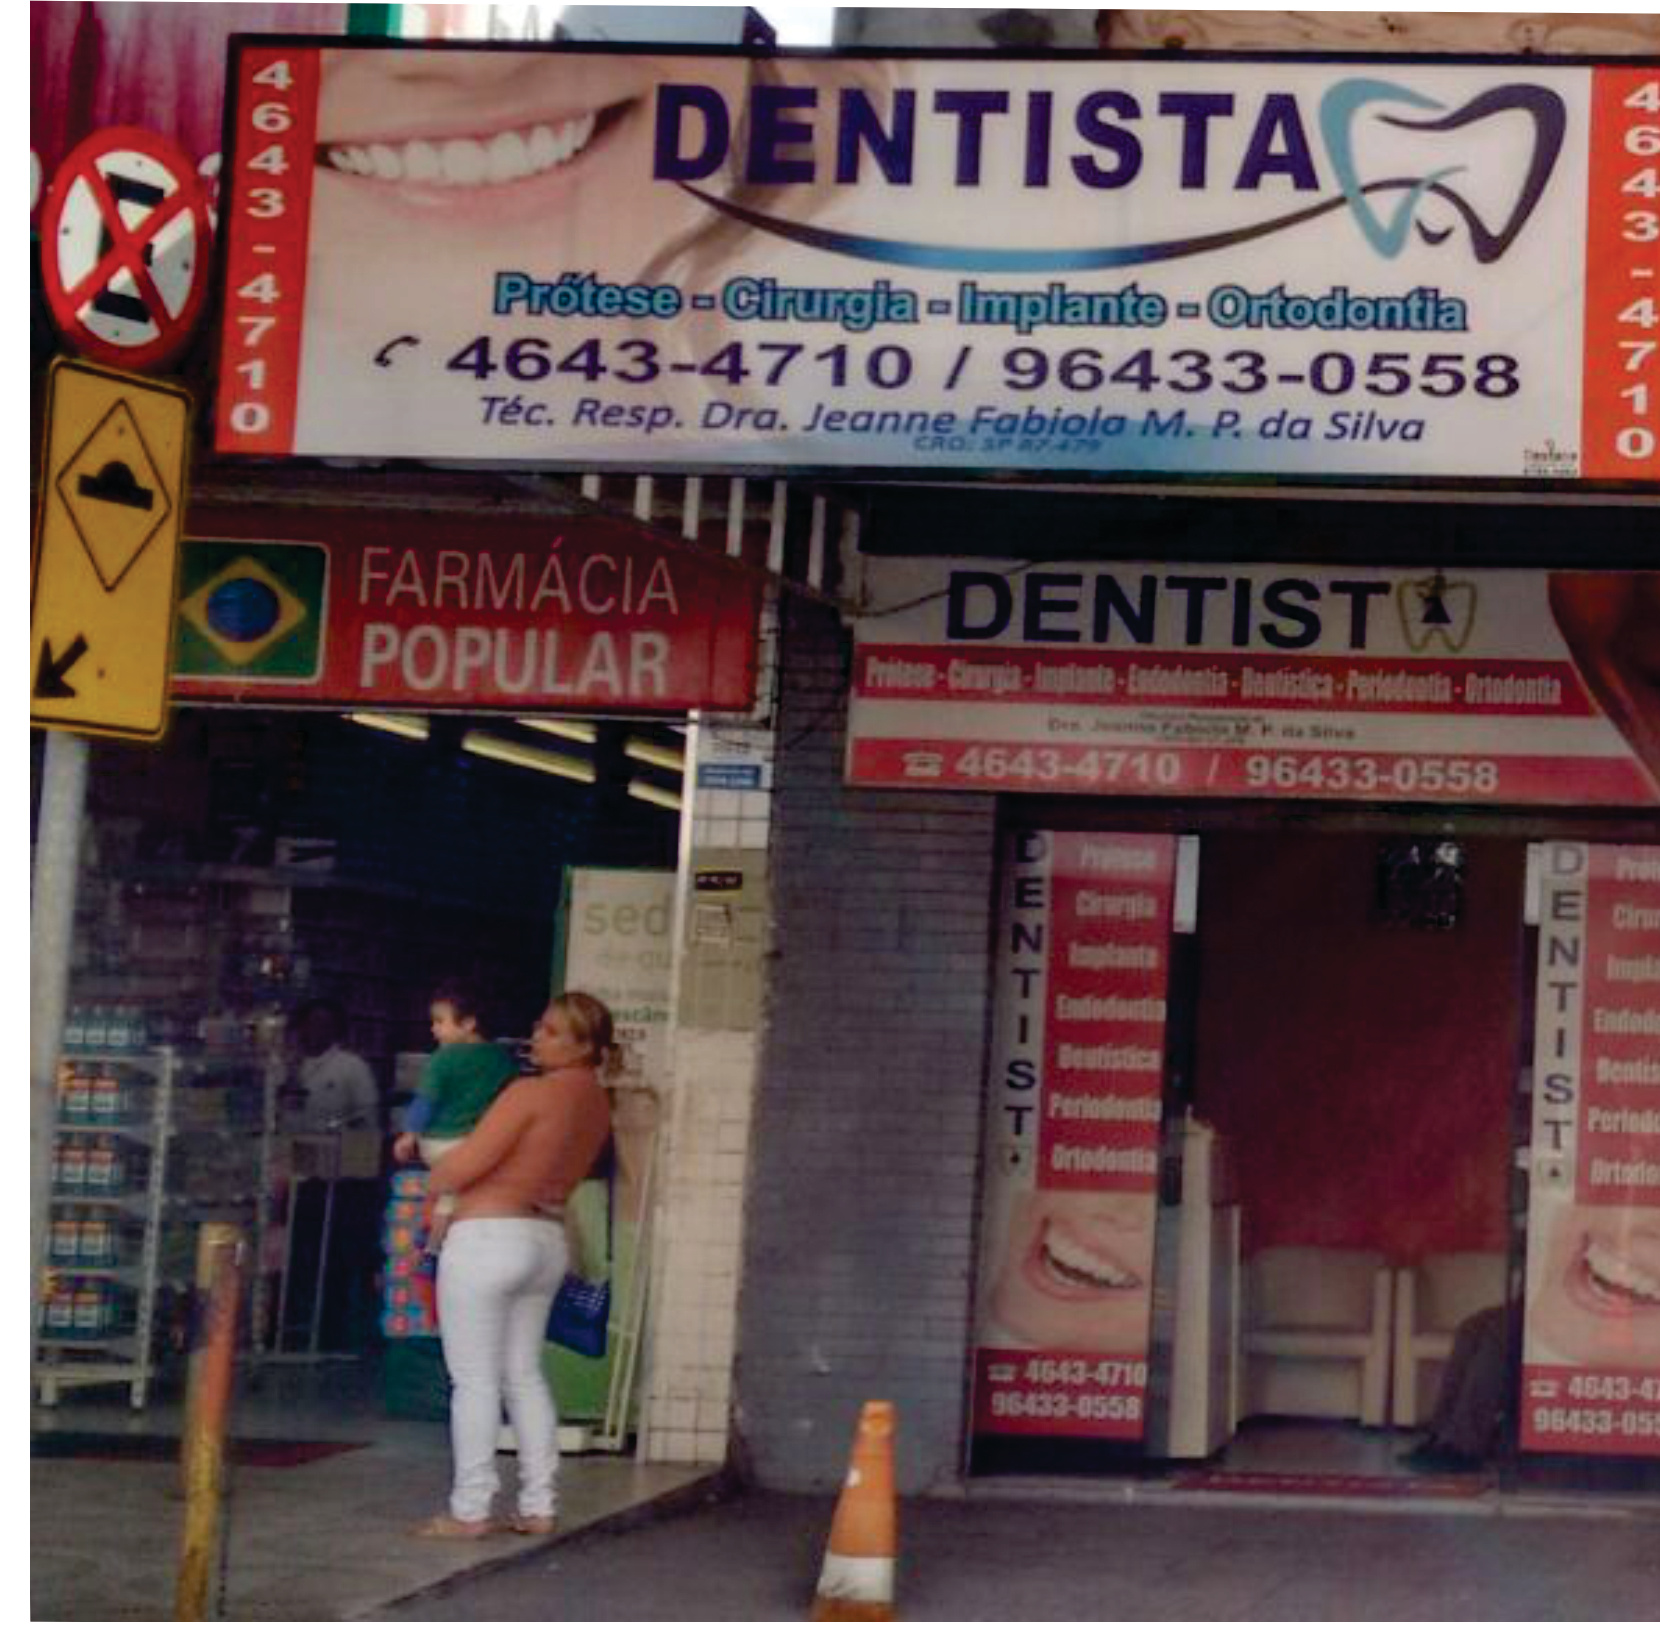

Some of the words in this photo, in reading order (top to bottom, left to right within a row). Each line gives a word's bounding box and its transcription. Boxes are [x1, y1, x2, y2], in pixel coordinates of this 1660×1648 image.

[652, 83, 1319, 190] DENTISTA
[228, 60, 294, 434] 4643-4710
[493, 271, 681, 318] Prótese
[723, 277, 920, 332] Cirurgia
[958, 282, 1168, 333] Implante
[1206, 284, 1468, 333] Ortodontia
[446, 336, 913, 390] 4643-4710
[1002, 347, 1521, 398] 96433-0558
[480, 397, 555, 427] Téc.
[573, 398, 684, 434] Resp.
[702, 402, 788, 433] Dra.
[803, 405, 954, 436] Jeanne
[970, 406, 1127, 438] Fabiola
[1140, 409, 1186, 438] M.
[1213, 410, 1243, 438] P.
[1259, 410, 1311, 441] da
[1325, 411, 1425, 442] Silva
[359, 536, 679, 616] FARMÁCIA
[946, 569, 1391, 649] DENTIST
[360, 622, 672, 697] POPULAR
[956, 745, 1181, 785] 4643-4710
[1245, 754, 1499, 792] 96433-0558
[583, 888, 671, 937] sed
[1056, 994, 1166, 1022] Endodontia
[1050, 1093, 1163, 1122] Periodontia
[1052, 1145, 1158, 1174] Ortodontia
[1025, 1359, 1148, 1388] 4643-4710
[991, 1391, 1141, 1421] 96433-0558
